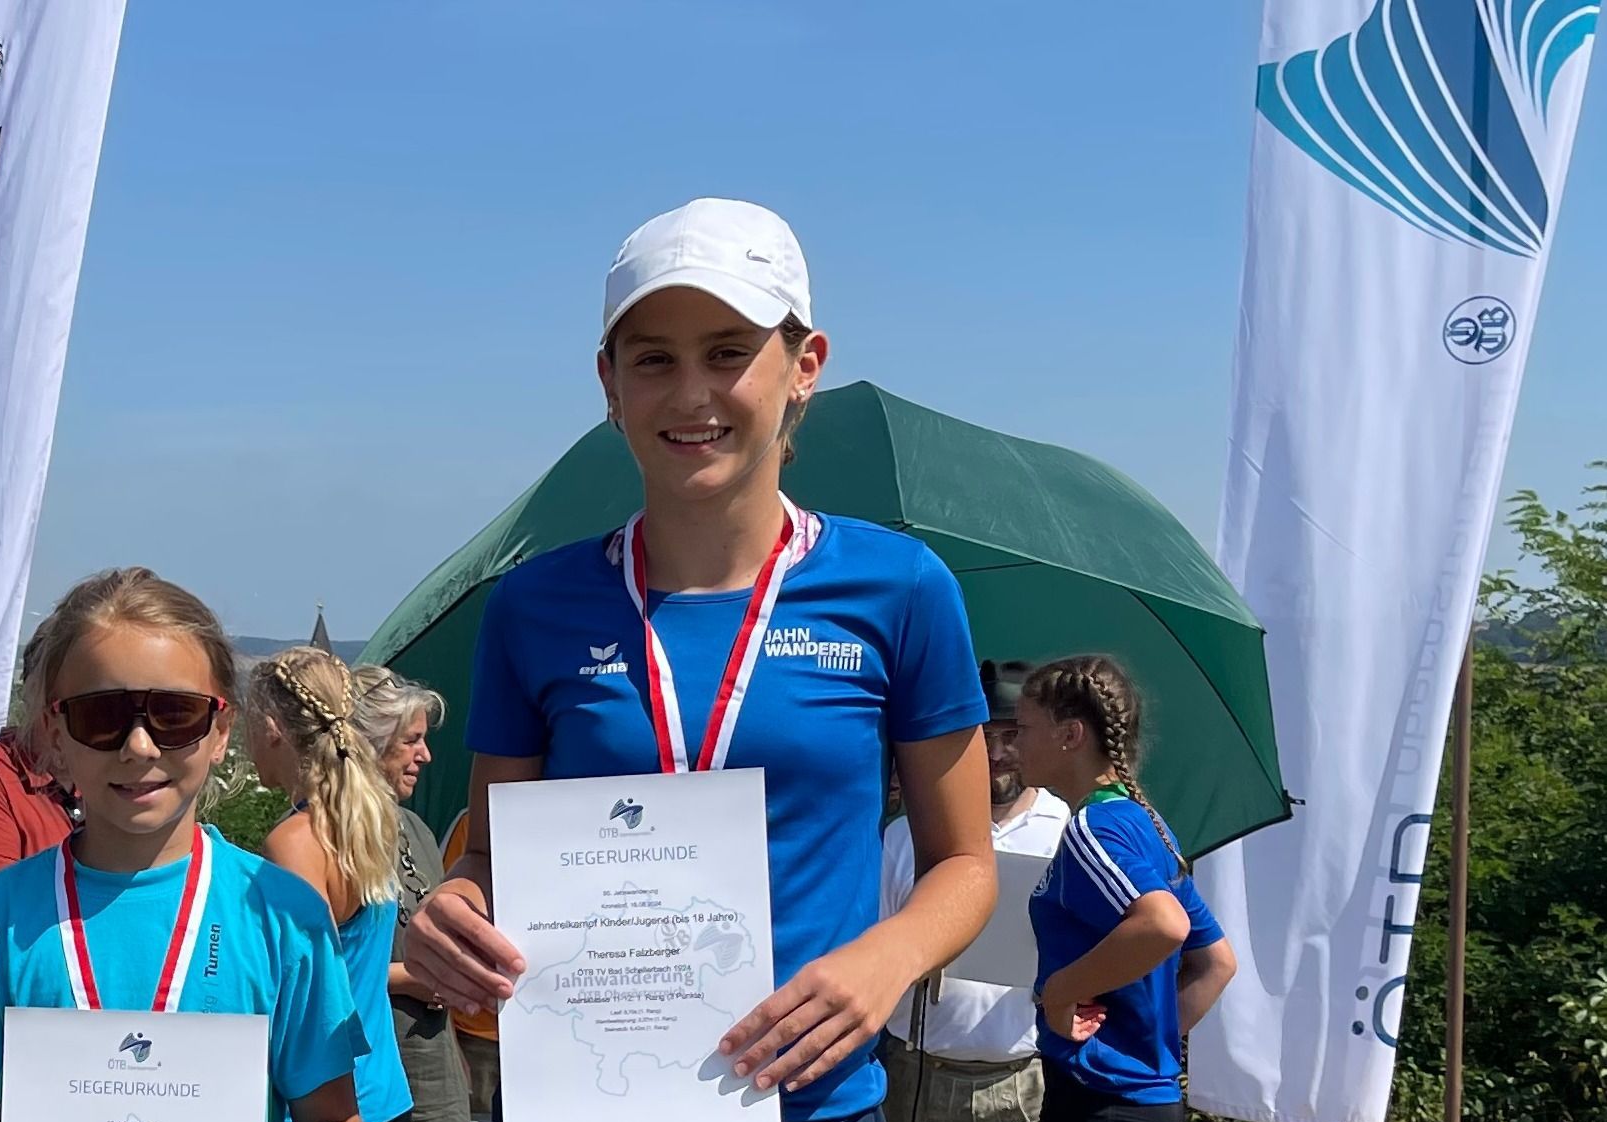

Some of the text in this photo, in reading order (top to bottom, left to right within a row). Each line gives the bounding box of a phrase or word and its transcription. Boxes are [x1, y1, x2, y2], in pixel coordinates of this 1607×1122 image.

[764, 628, 810, 643] JAHN
[764, 642, 863, 658] WANDERER
[578, 662, 629, 675] erima
[599, 827, 618, 839] ÖTB
[560, 845, 698, 867] SIEGERURKUNDE
[527, 911, 738, 931] Jahndreikampf Kinder/Jugend (bis 18 Jahre)
[204, 924, 222, 978] Turnen
[587, 949, 627, 959] Theresa
[596, 968, 606, 976] TV
[608, 967, 623, 975] Bad
[554, 970, 694, 991] Jahnwanderung
[108, 1058, 127, 1070] ÖTB
[69, 1080, 201, 1098] SIEGERURKUNDE
